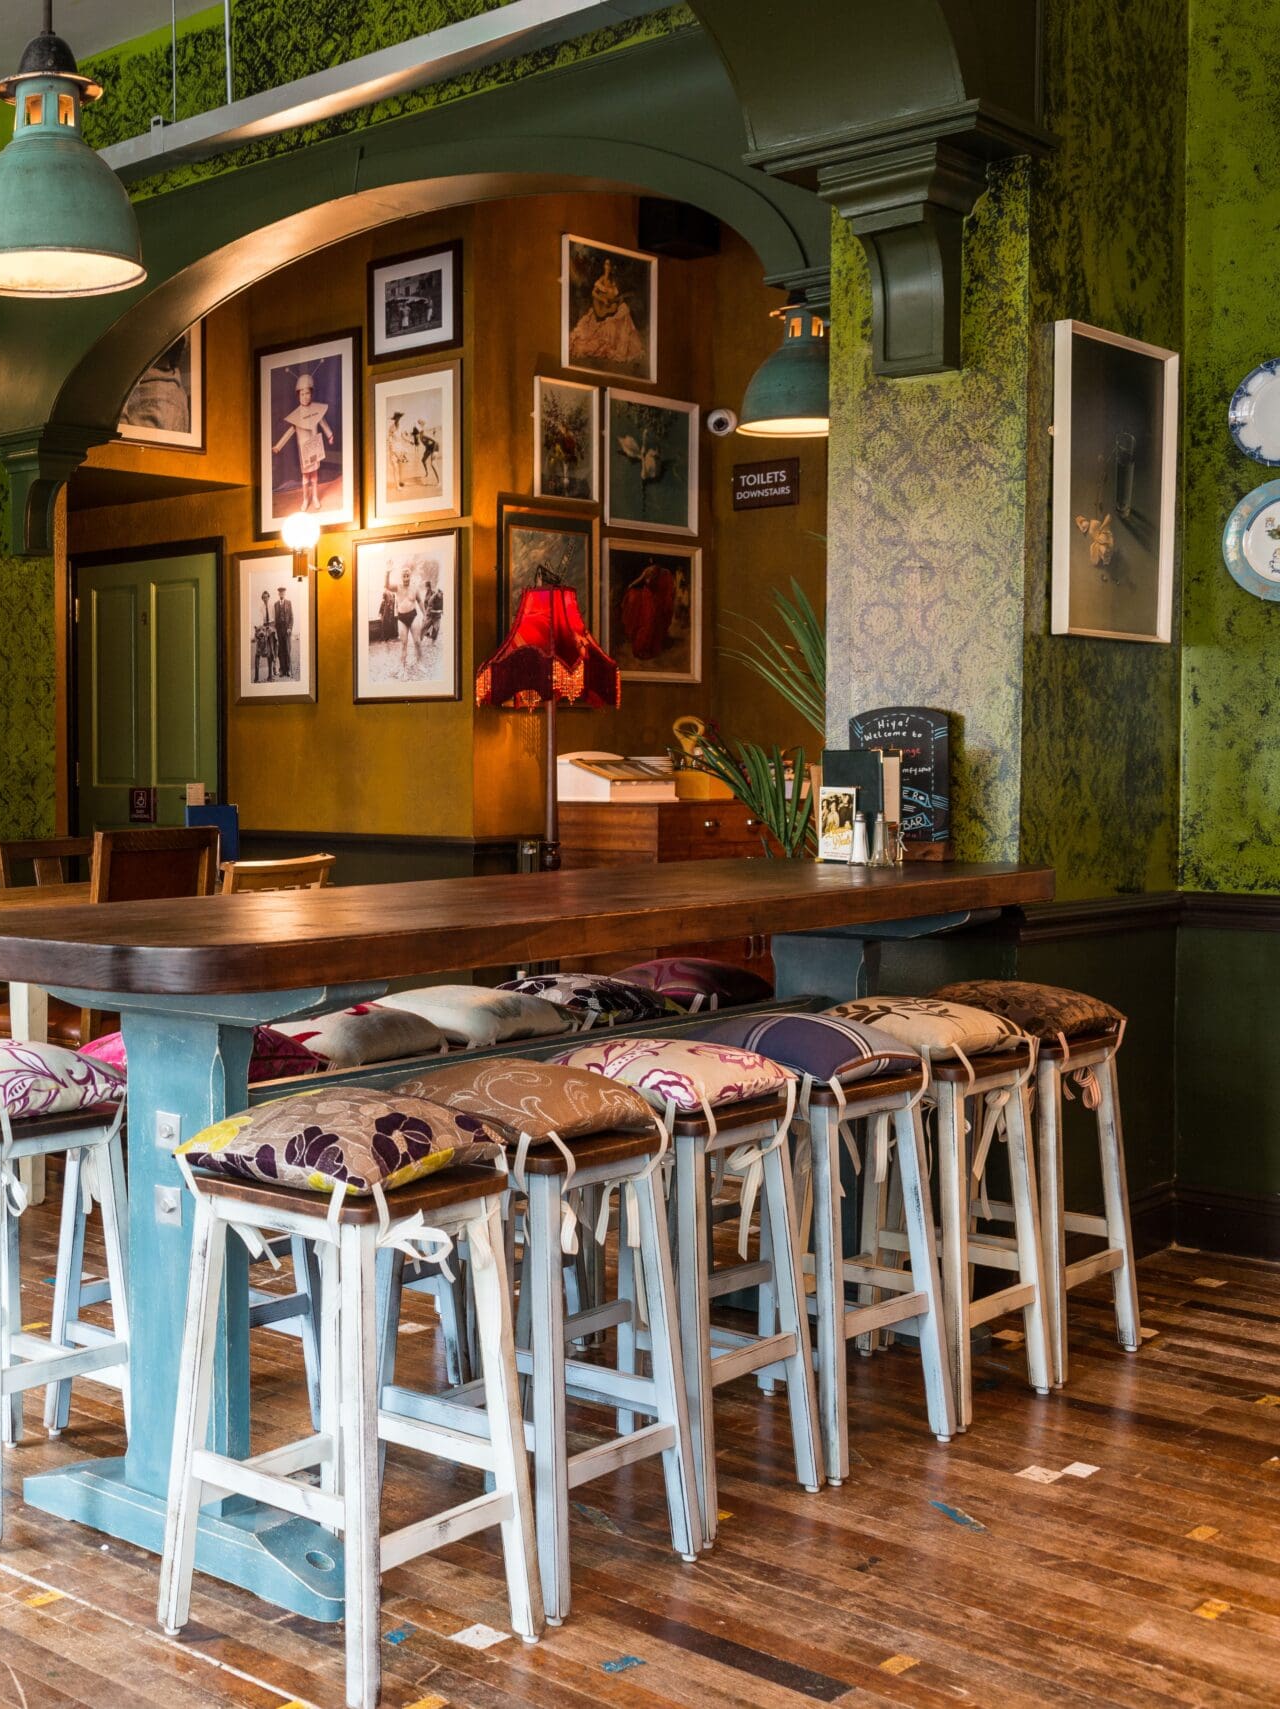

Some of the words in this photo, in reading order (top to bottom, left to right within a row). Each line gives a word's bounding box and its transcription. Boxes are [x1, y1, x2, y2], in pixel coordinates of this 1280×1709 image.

[739, 470, 787, 487] TOILETS
[736, 485, 791, 500] DOWNSTAIRS
[877, 716, 910, 730] Hiya!
[864, 731, 907, 741] Welcome
[903, 816, 923, 831] BAR
